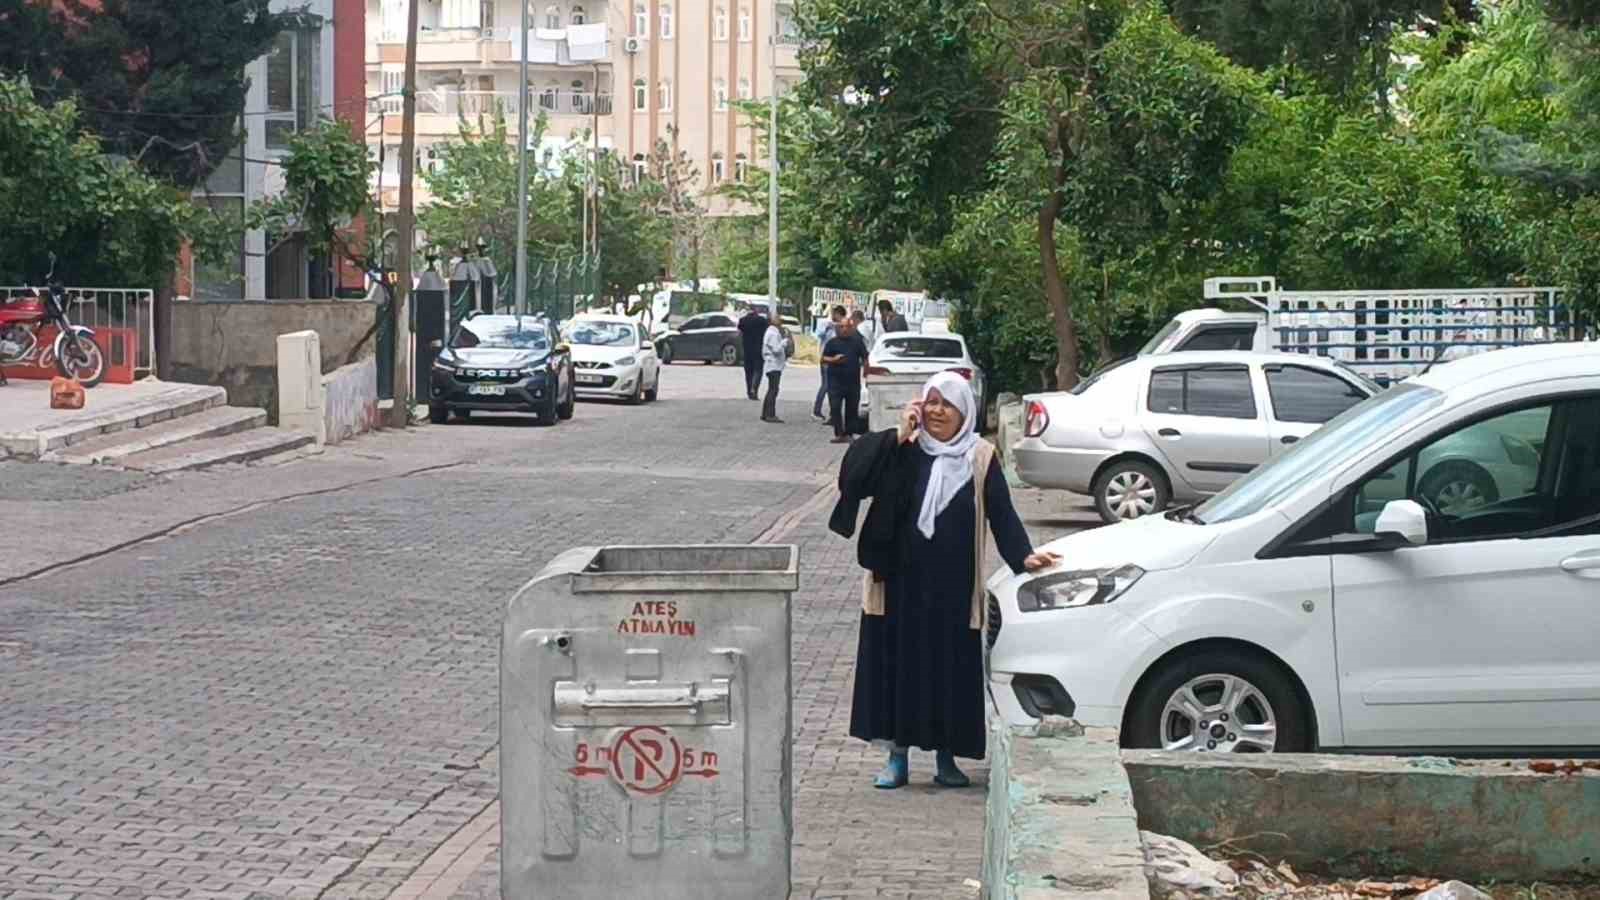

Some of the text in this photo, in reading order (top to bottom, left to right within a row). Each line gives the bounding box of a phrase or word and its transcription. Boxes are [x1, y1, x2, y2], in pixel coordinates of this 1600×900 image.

[632, 601, 678, 618] ATEŞ
[617, 618, 696, 636] ATMAYIN
[701, 751, 718, 766] m
